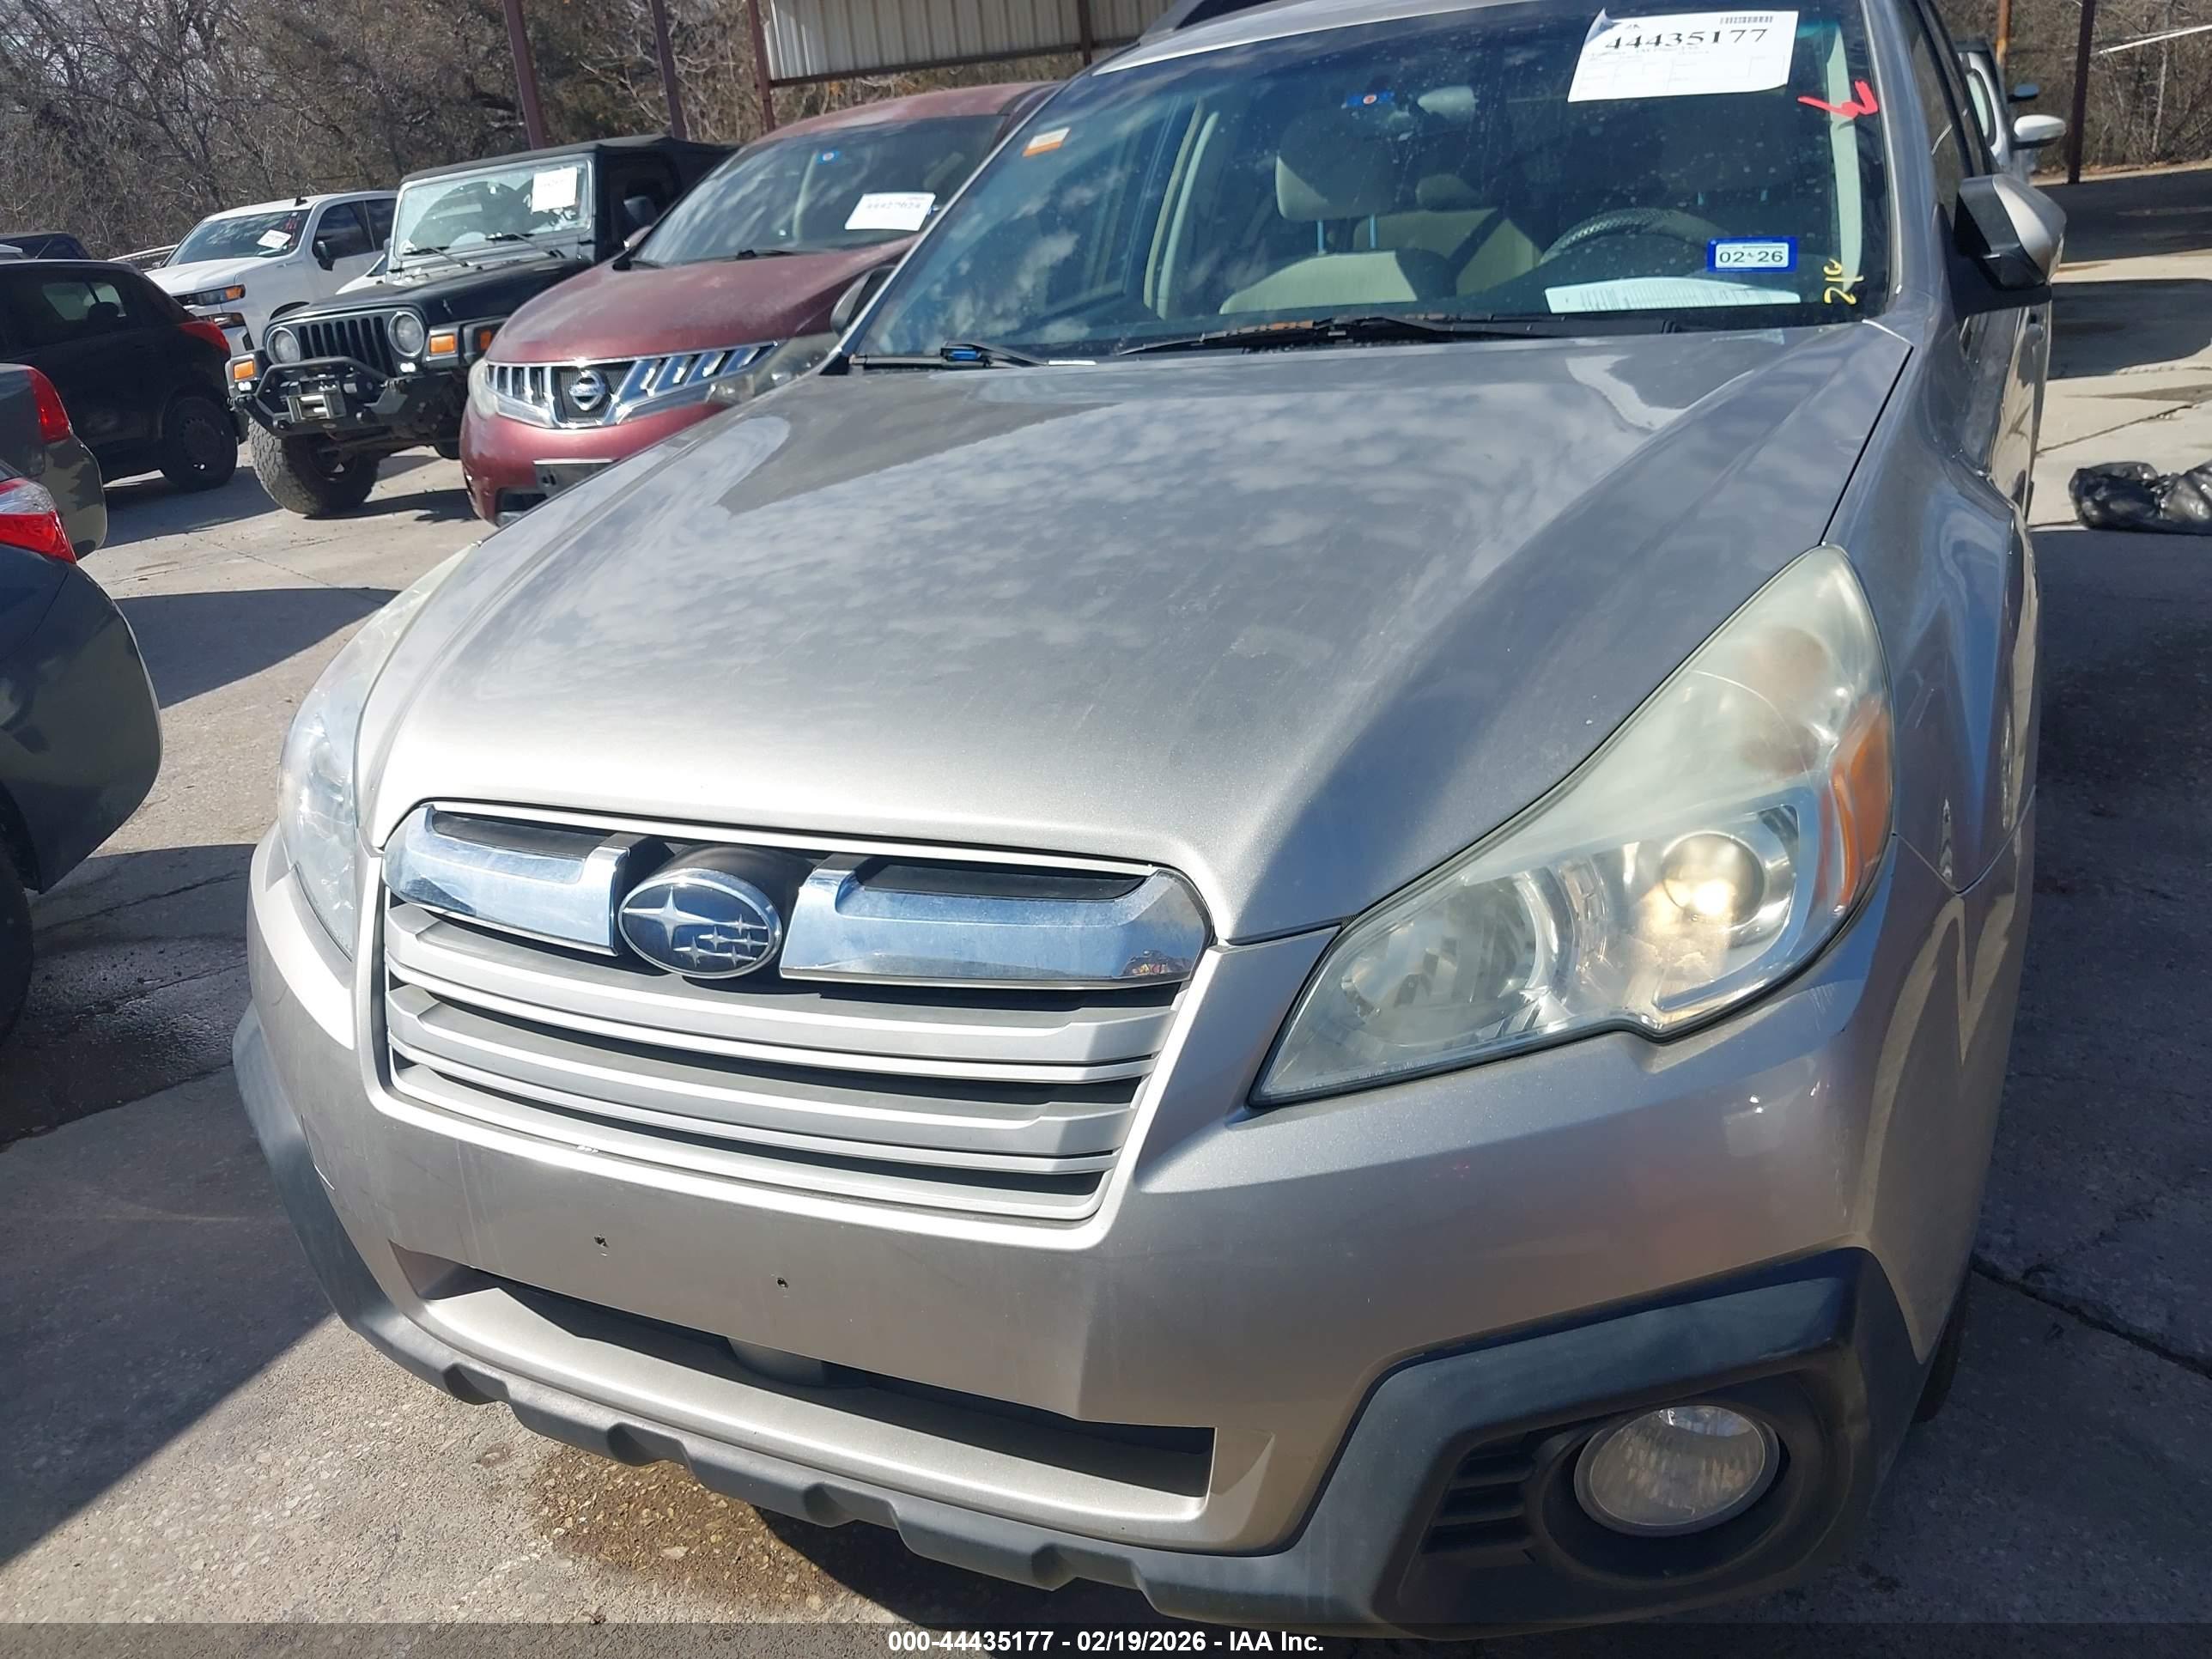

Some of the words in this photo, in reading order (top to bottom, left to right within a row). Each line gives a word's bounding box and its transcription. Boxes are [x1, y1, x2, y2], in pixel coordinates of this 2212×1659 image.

[1604, 28, 1768, 50] 44435177
[1719, 252, 1745, 263] 02
[1758, 251, 1784, 263] 26
